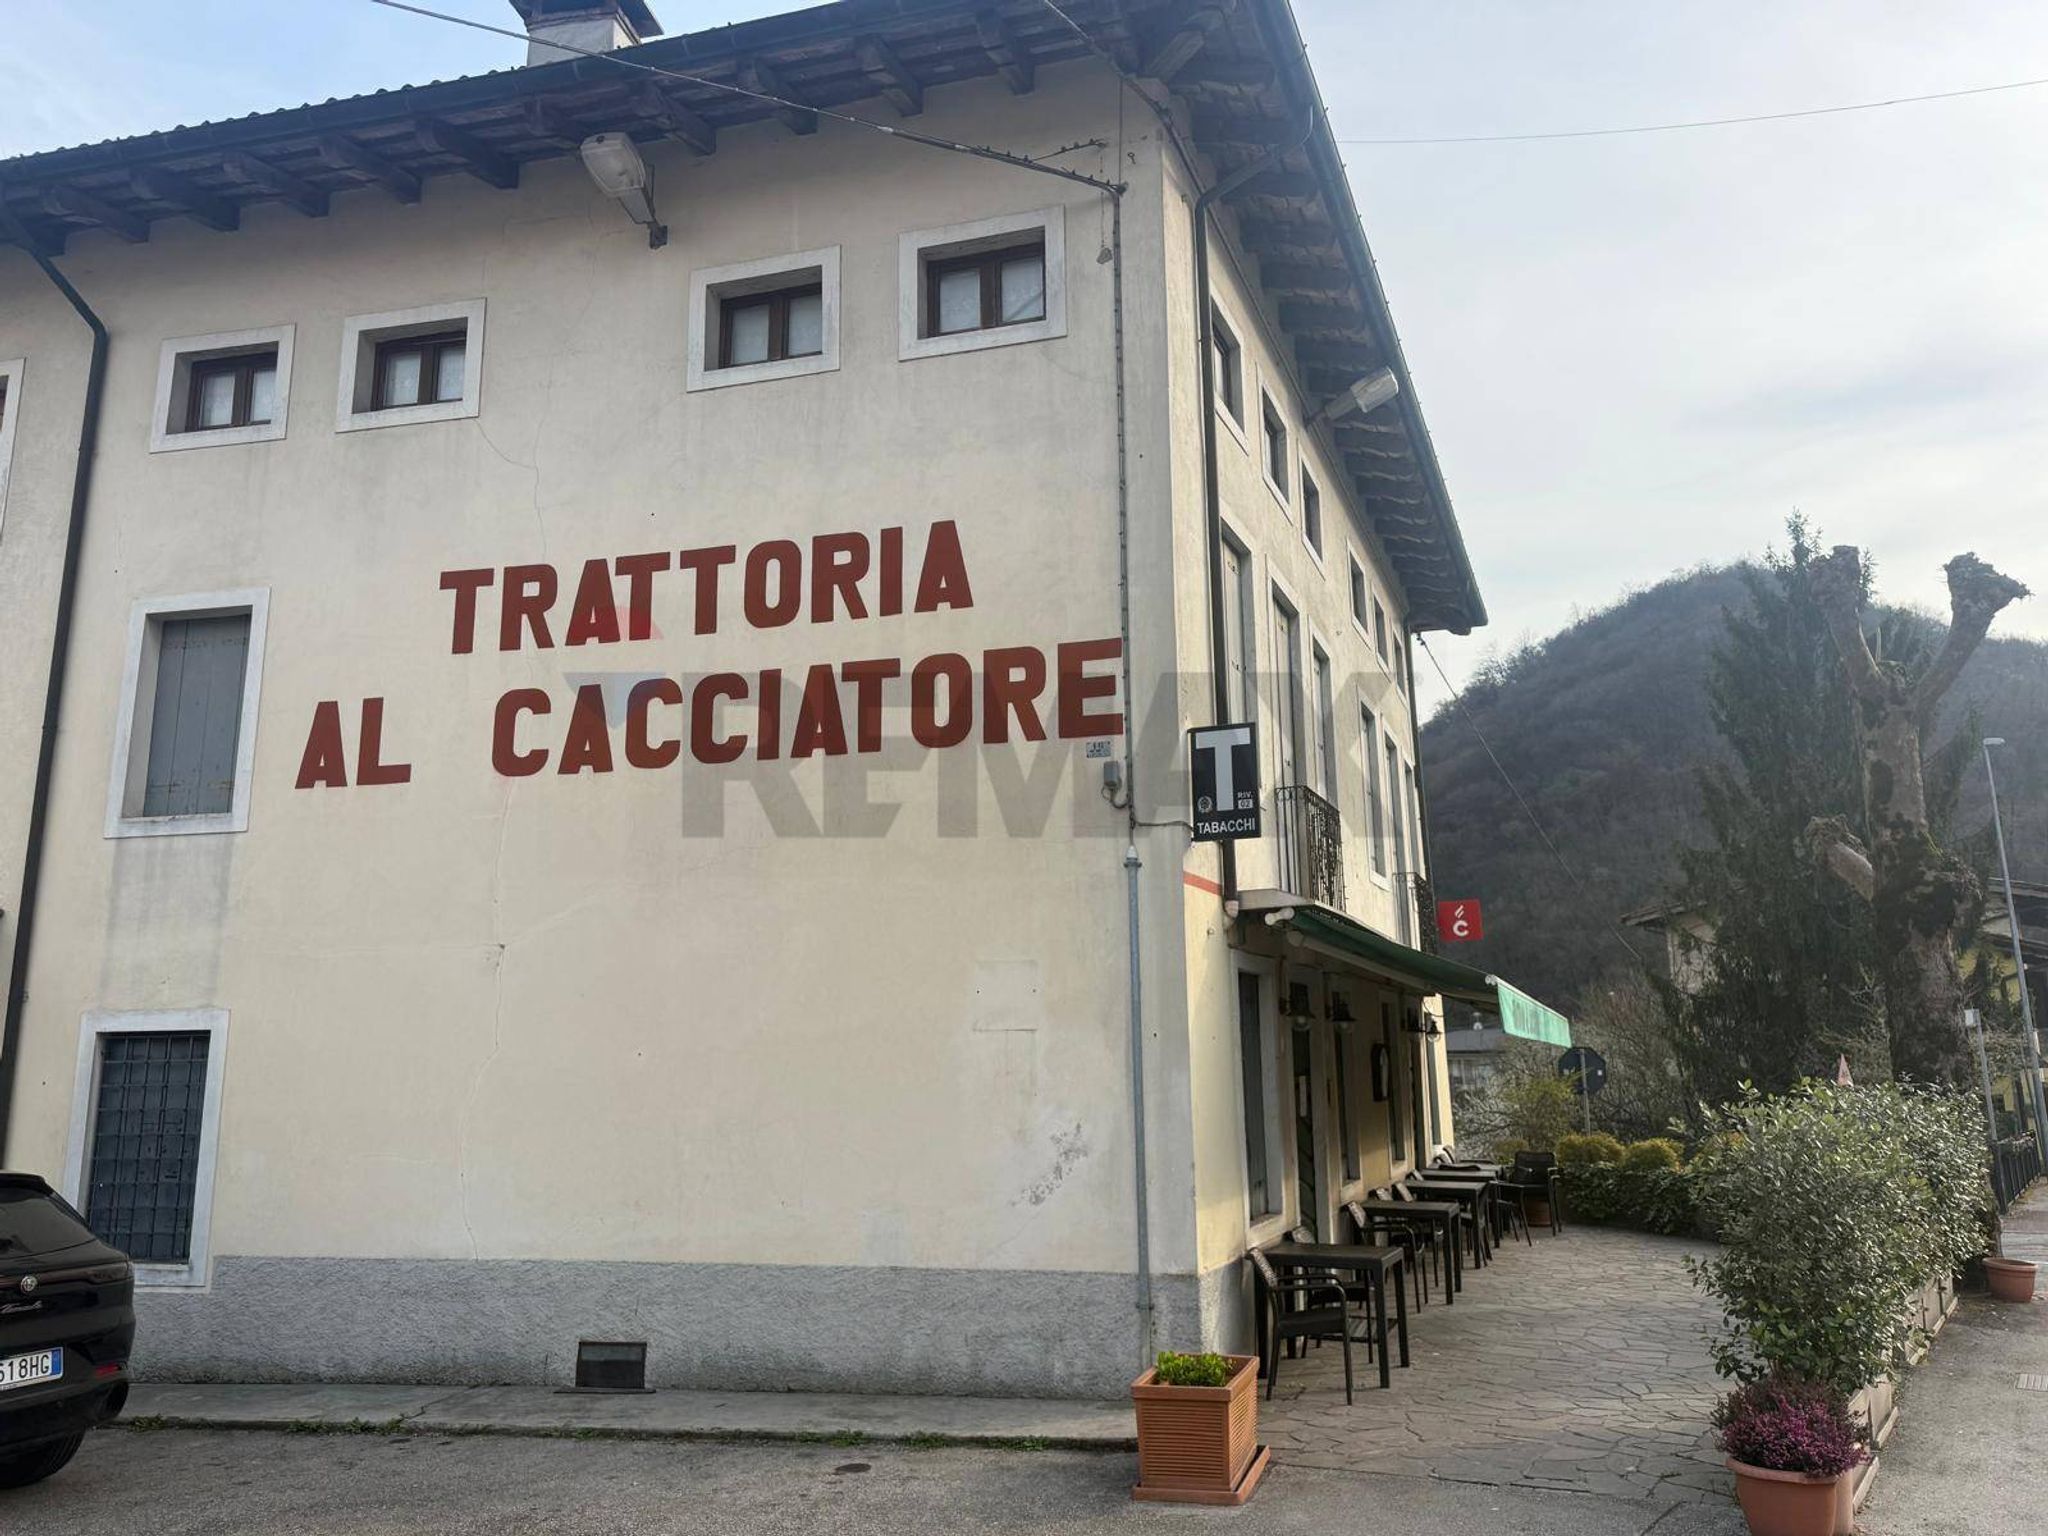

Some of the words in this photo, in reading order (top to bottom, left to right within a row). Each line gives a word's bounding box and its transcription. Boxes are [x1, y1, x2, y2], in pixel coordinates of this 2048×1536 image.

[440, 520, 973, 655] TRATTORIA
[295, 697, 412, 789] AL
[490, 638, 1124, 778] CACCIATORE
[1195, 728, 1250, 811] T
[1197, 818, 1256, 834] TABACCHI
